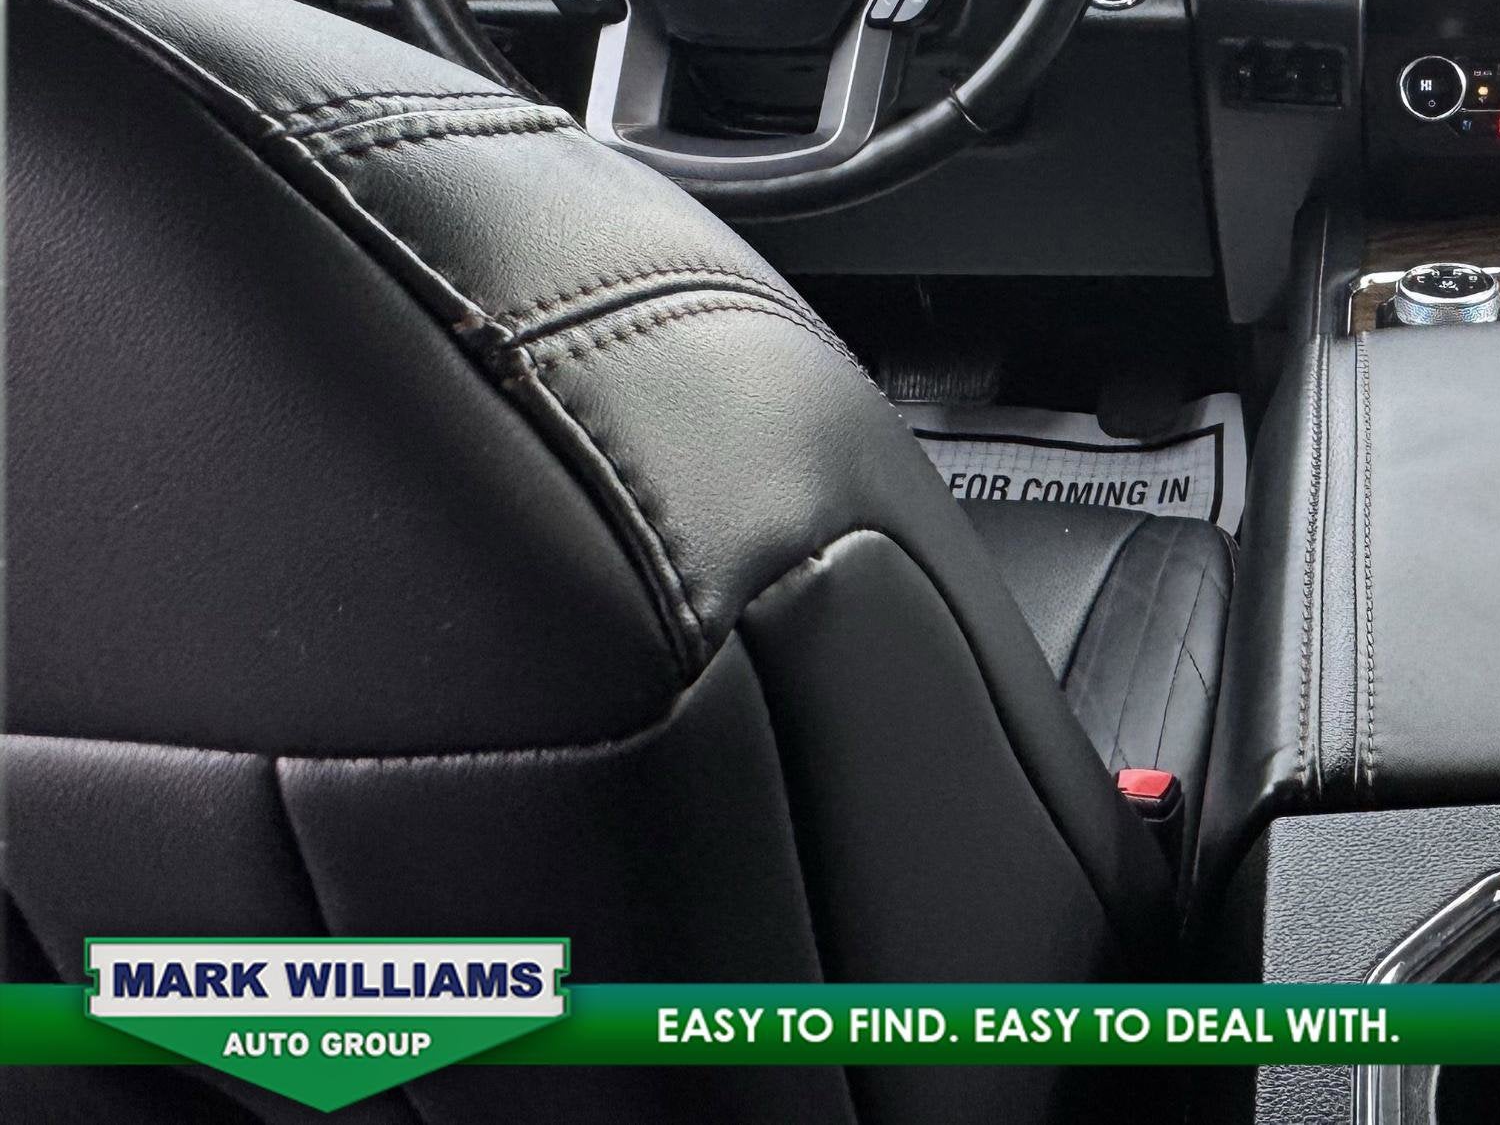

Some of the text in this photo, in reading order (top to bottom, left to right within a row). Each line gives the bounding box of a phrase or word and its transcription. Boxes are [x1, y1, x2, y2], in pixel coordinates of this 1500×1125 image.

[950, 472, 1191, 506] FOR COMING IN
